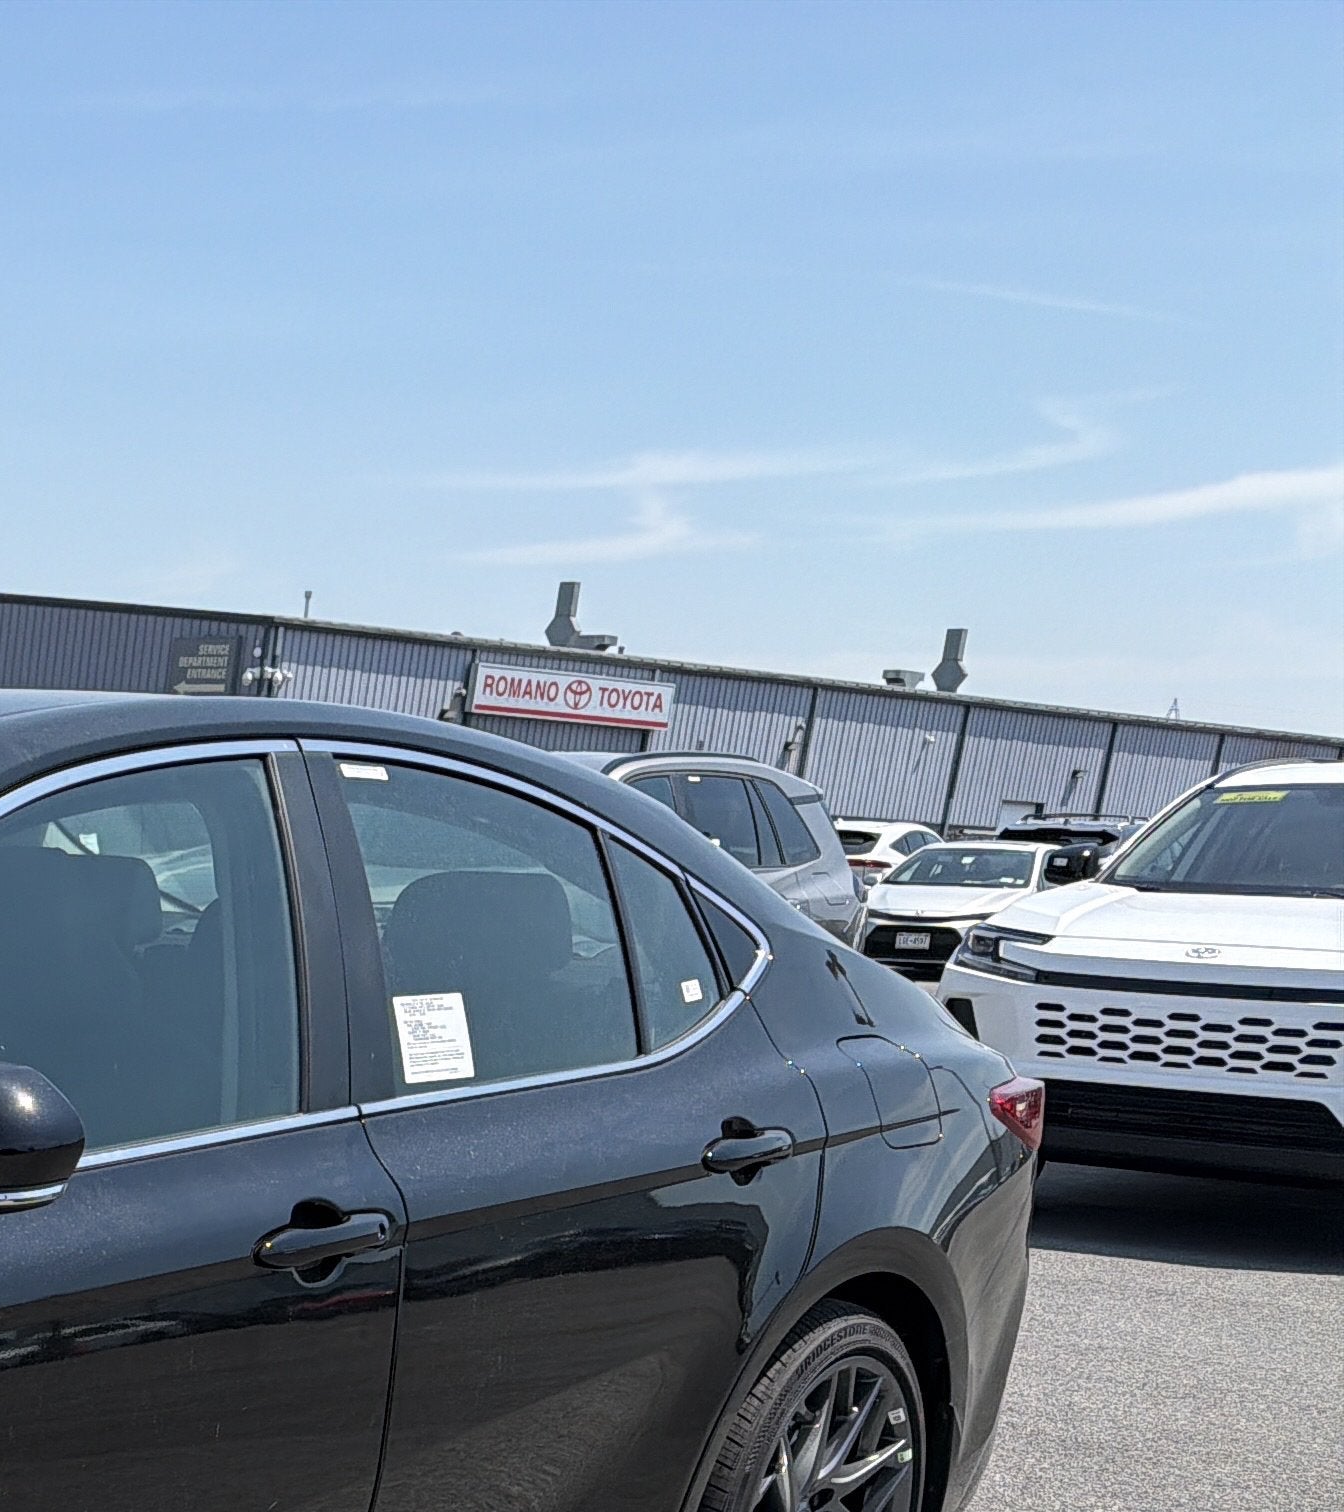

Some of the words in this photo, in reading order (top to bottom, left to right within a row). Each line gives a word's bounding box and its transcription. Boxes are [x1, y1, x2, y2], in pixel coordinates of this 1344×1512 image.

[197, 643, 231, 656] SERVICE
[178, 656, 229, 668] DEPARTMENT
[186, 668, 228, 680] ENTRANCE
[482, 674, 560, 703] ROMANO
[598, 686, 664, 714] TOYOTA
